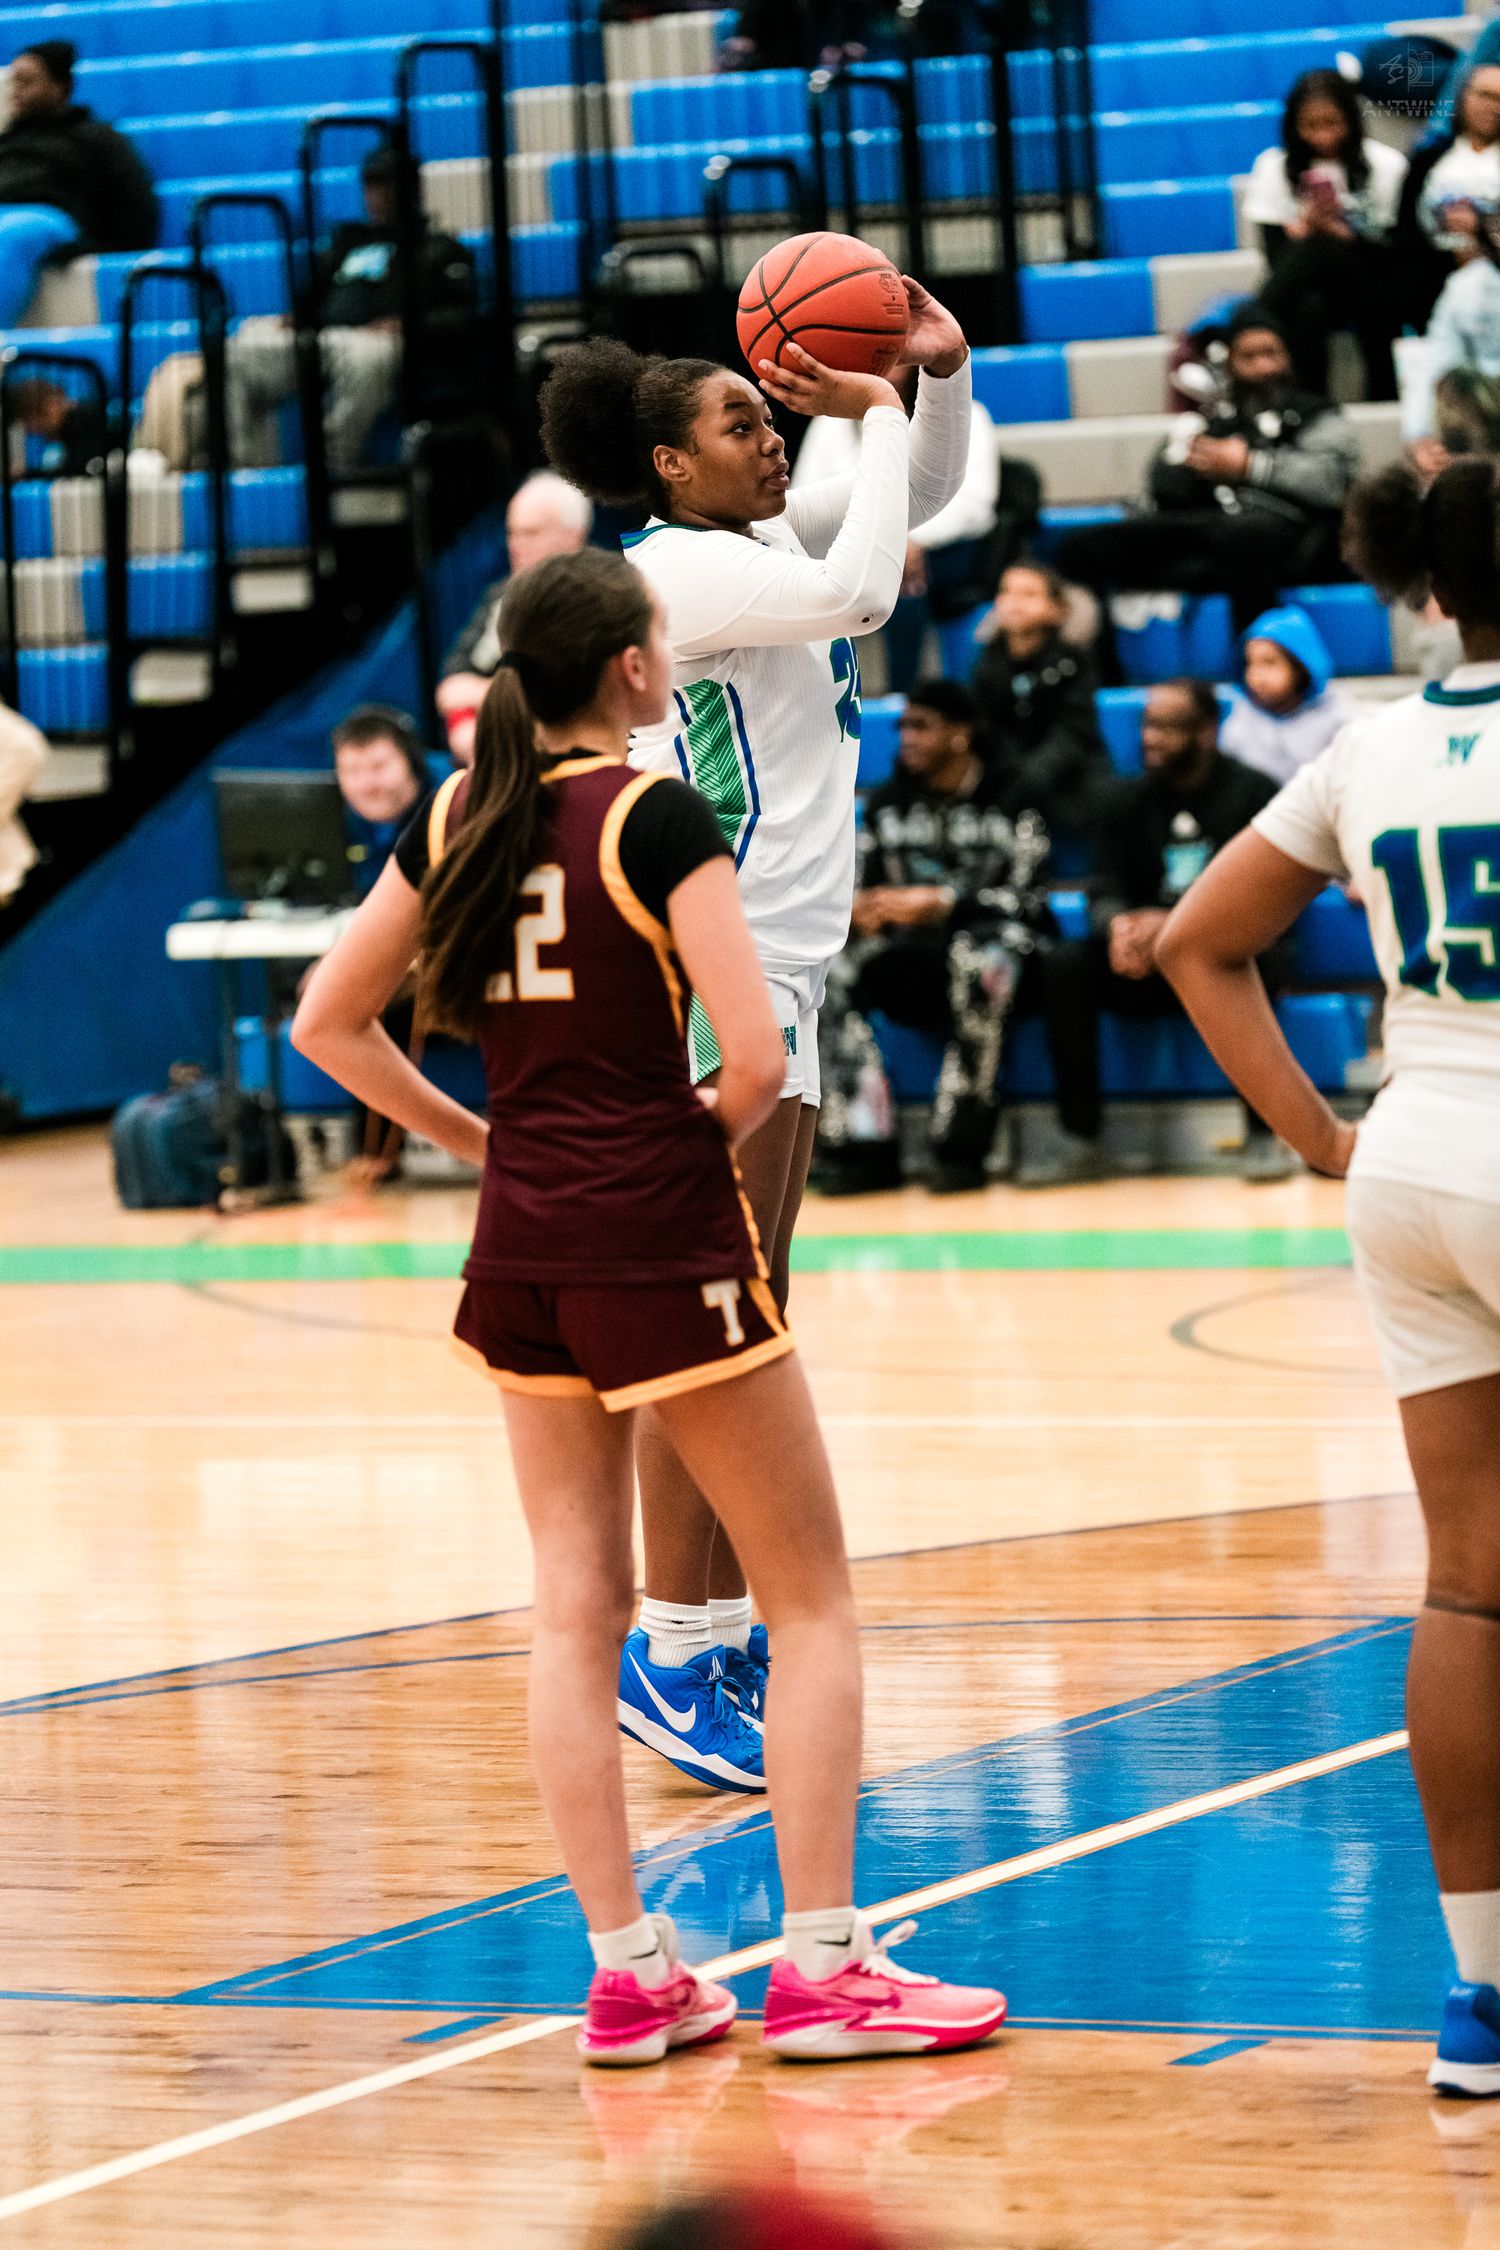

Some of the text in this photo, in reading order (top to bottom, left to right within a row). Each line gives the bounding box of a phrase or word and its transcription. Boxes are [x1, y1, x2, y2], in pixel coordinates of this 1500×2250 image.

[485, 863, 576, 1002] 2
[1371, 823, 1500, 1002] 15
[702, 1279, 745, 1347] T
